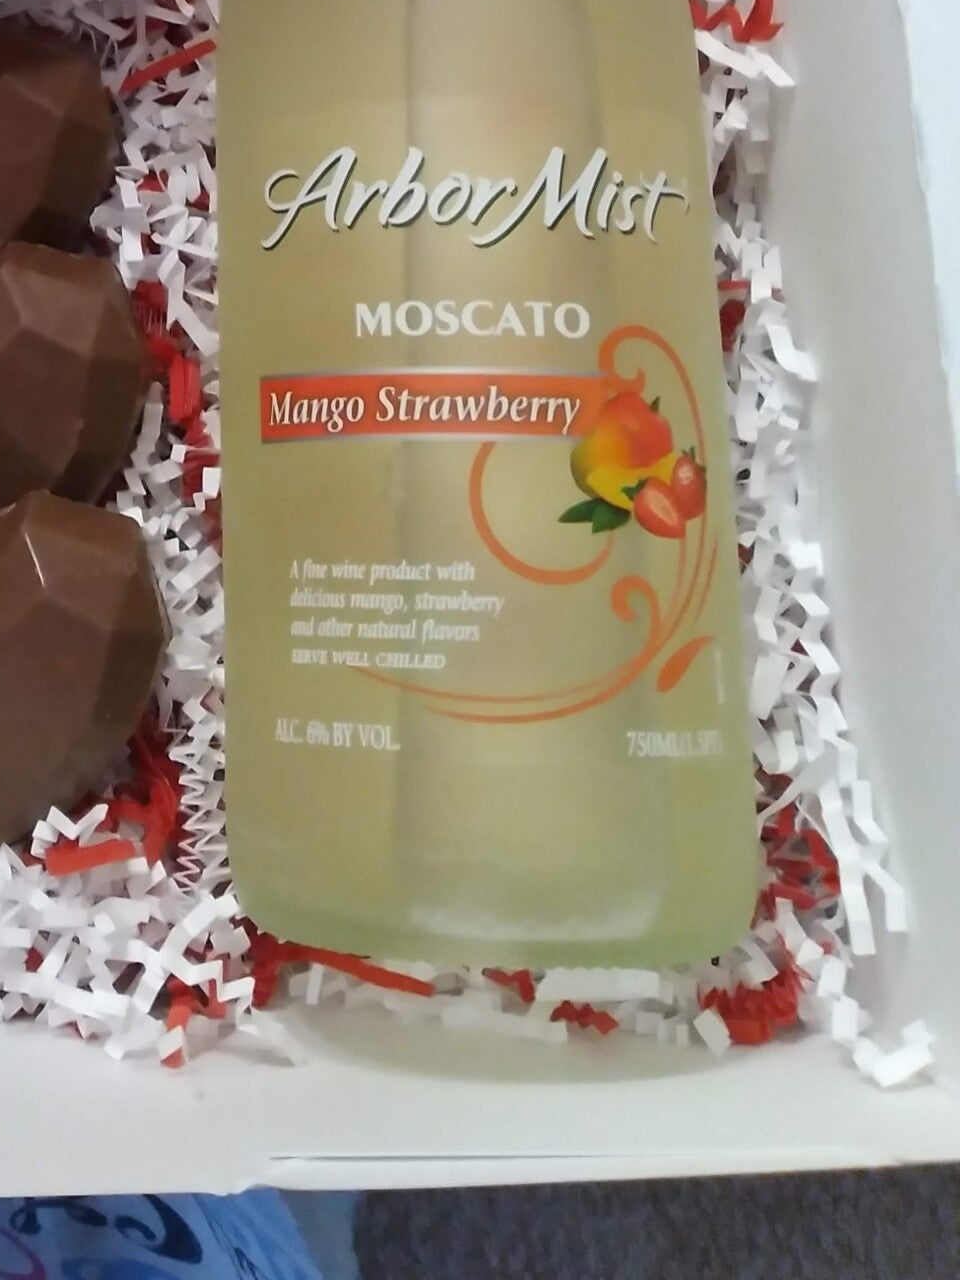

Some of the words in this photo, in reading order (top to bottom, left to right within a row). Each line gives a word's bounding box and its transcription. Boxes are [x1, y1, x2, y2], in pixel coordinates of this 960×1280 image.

[261, 146, 517, 250] Arbor
[354, 300, 591, 339] MOSCATO
[269, 390, 365, 433] Mango
[375, 385, 581, 435] Strawberry
[289, 559, 300, 579] A
[302, 558, 328, 584] fine
[331, 561, 366, 580] wine
[370, 560, 431, 587] product
[437, 560, 475, 582] with
[290, 587, 346, 608] delicious
[350, 591, 409, 615] mango,
[414, 591, 505, 617] strawberry
[291, 617, 314, 637] and
[318, 617, 353, 638] other
[358, 619, 417, 640] natural
[421, 619, 481, 645] flavors
[332, 651, 371, 667] WELL
[375, 653, 447, 669] CHILLED
[333, 722, 353, 748] BY
